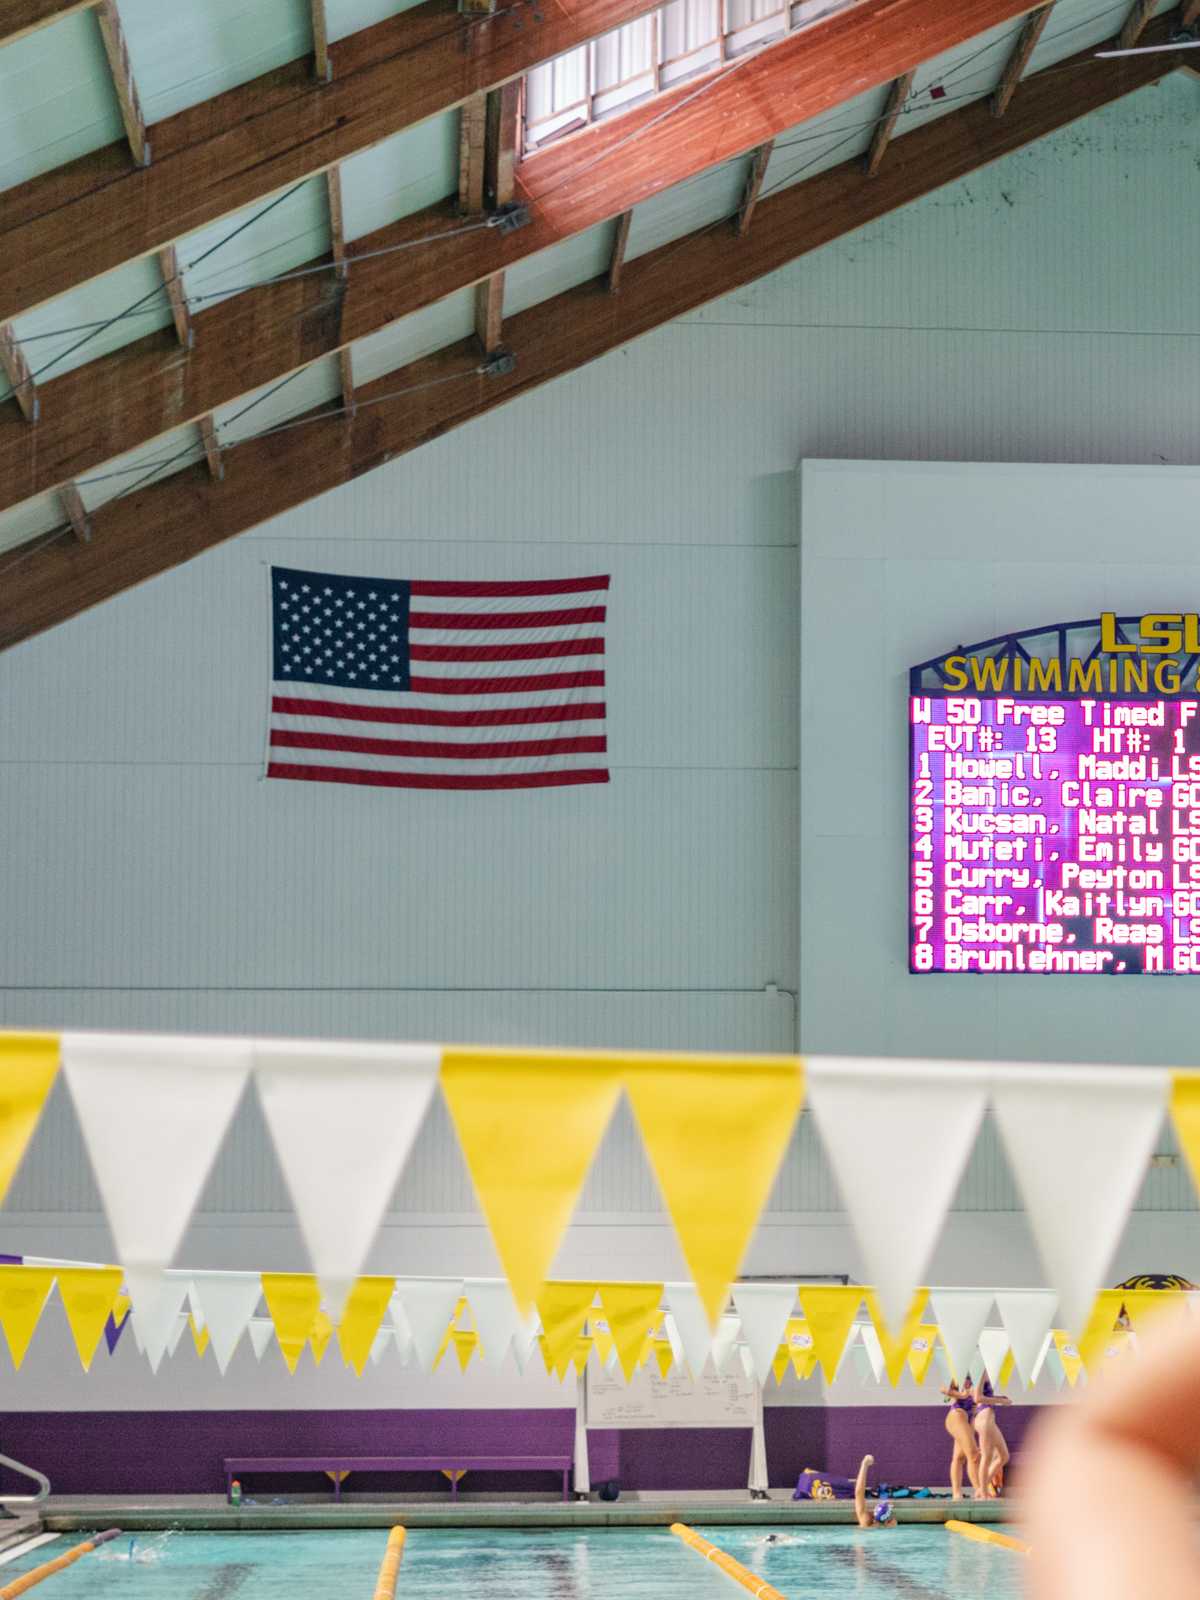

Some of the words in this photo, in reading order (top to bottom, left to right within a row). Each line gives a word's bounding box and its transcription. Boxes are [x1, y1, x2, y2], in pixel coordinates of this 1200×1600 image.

[943, 655, 1181, 695] SWIMMING
[946, 698, 981, 724] 50
[996, 698, 1065, 725] Free
[1081, 699, 1165, 727] Timed
[928, 725, 1003, 752] EVT#:
[1026, 726, 1057, 752] 13
[1093, 727, 1151, 753] HT#:
[1174, 728, 1186, 754] 1
[919, 752, 932, 779] 1
[945, 752, 1059, 779] Howell,
[1078, 753, 1160, 780] Maddi
[914, 779, 934, 806] 2
[945, 779, 1042, 806] Banic,
[1061, 780, 1163, 807] Claire
[914, 807, 934, 834] 3
[945, 807, 1060, 834] Kucsan,
[1078, 808, 1159, 835] Natal
[914, 834, 934, 861] 4
[945, 834, 1060, 861] Muteti,
[1078, 835, 1163, 862] Emily
[914, 861, 934, 888] 5
[945, 861, 1043, 888] Curry,
[1062, 862, 1163, 889] Peyton
[914, 888, 934, 915] 6
[945, 888, 1027, 915] Carr,
[1045, 889, 1163, 916] Kaitlyn
[914, 916, 934, 943] 7
[945, 916, 1077, 943] Osborne,
[914, 943, 934, 970] 8
[1146, 944, 1164, 971] M
